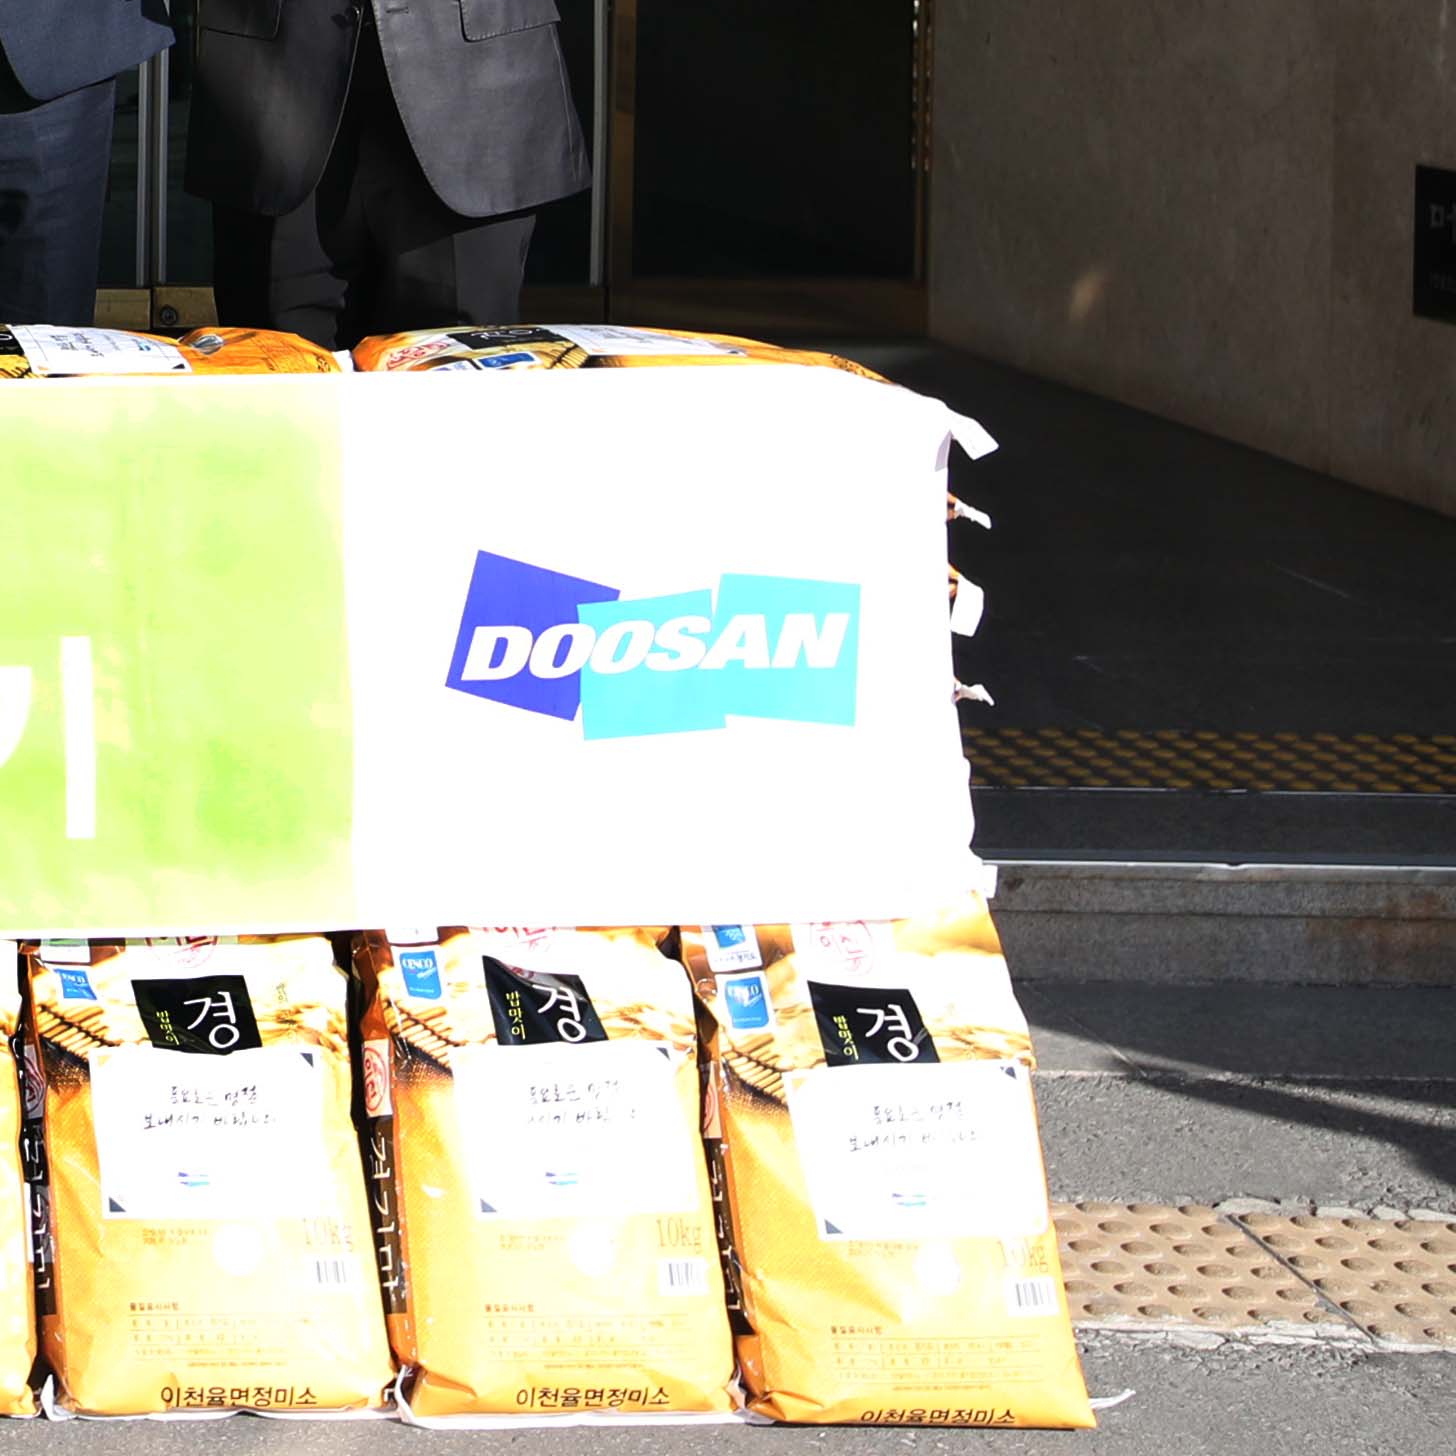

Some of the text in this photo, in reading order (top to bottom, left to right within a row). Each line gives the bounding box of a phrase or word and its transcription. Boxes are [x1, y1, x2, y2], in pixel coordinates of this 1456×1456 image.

[460, 611, 850, 682] DOOSAN
[184, 991, 240, 1050] 경
[506, 990, 527, 1041] 밥맛이
[533, 984, 587, 1043] 경
[857, 1002, 919, 1063] 경
[656, 1218, 703, 1254] 10kg
[160, 1386, 318, 1408] 이천율면정미소
[516, 1386, 672, 1408] 이천율면정미소
